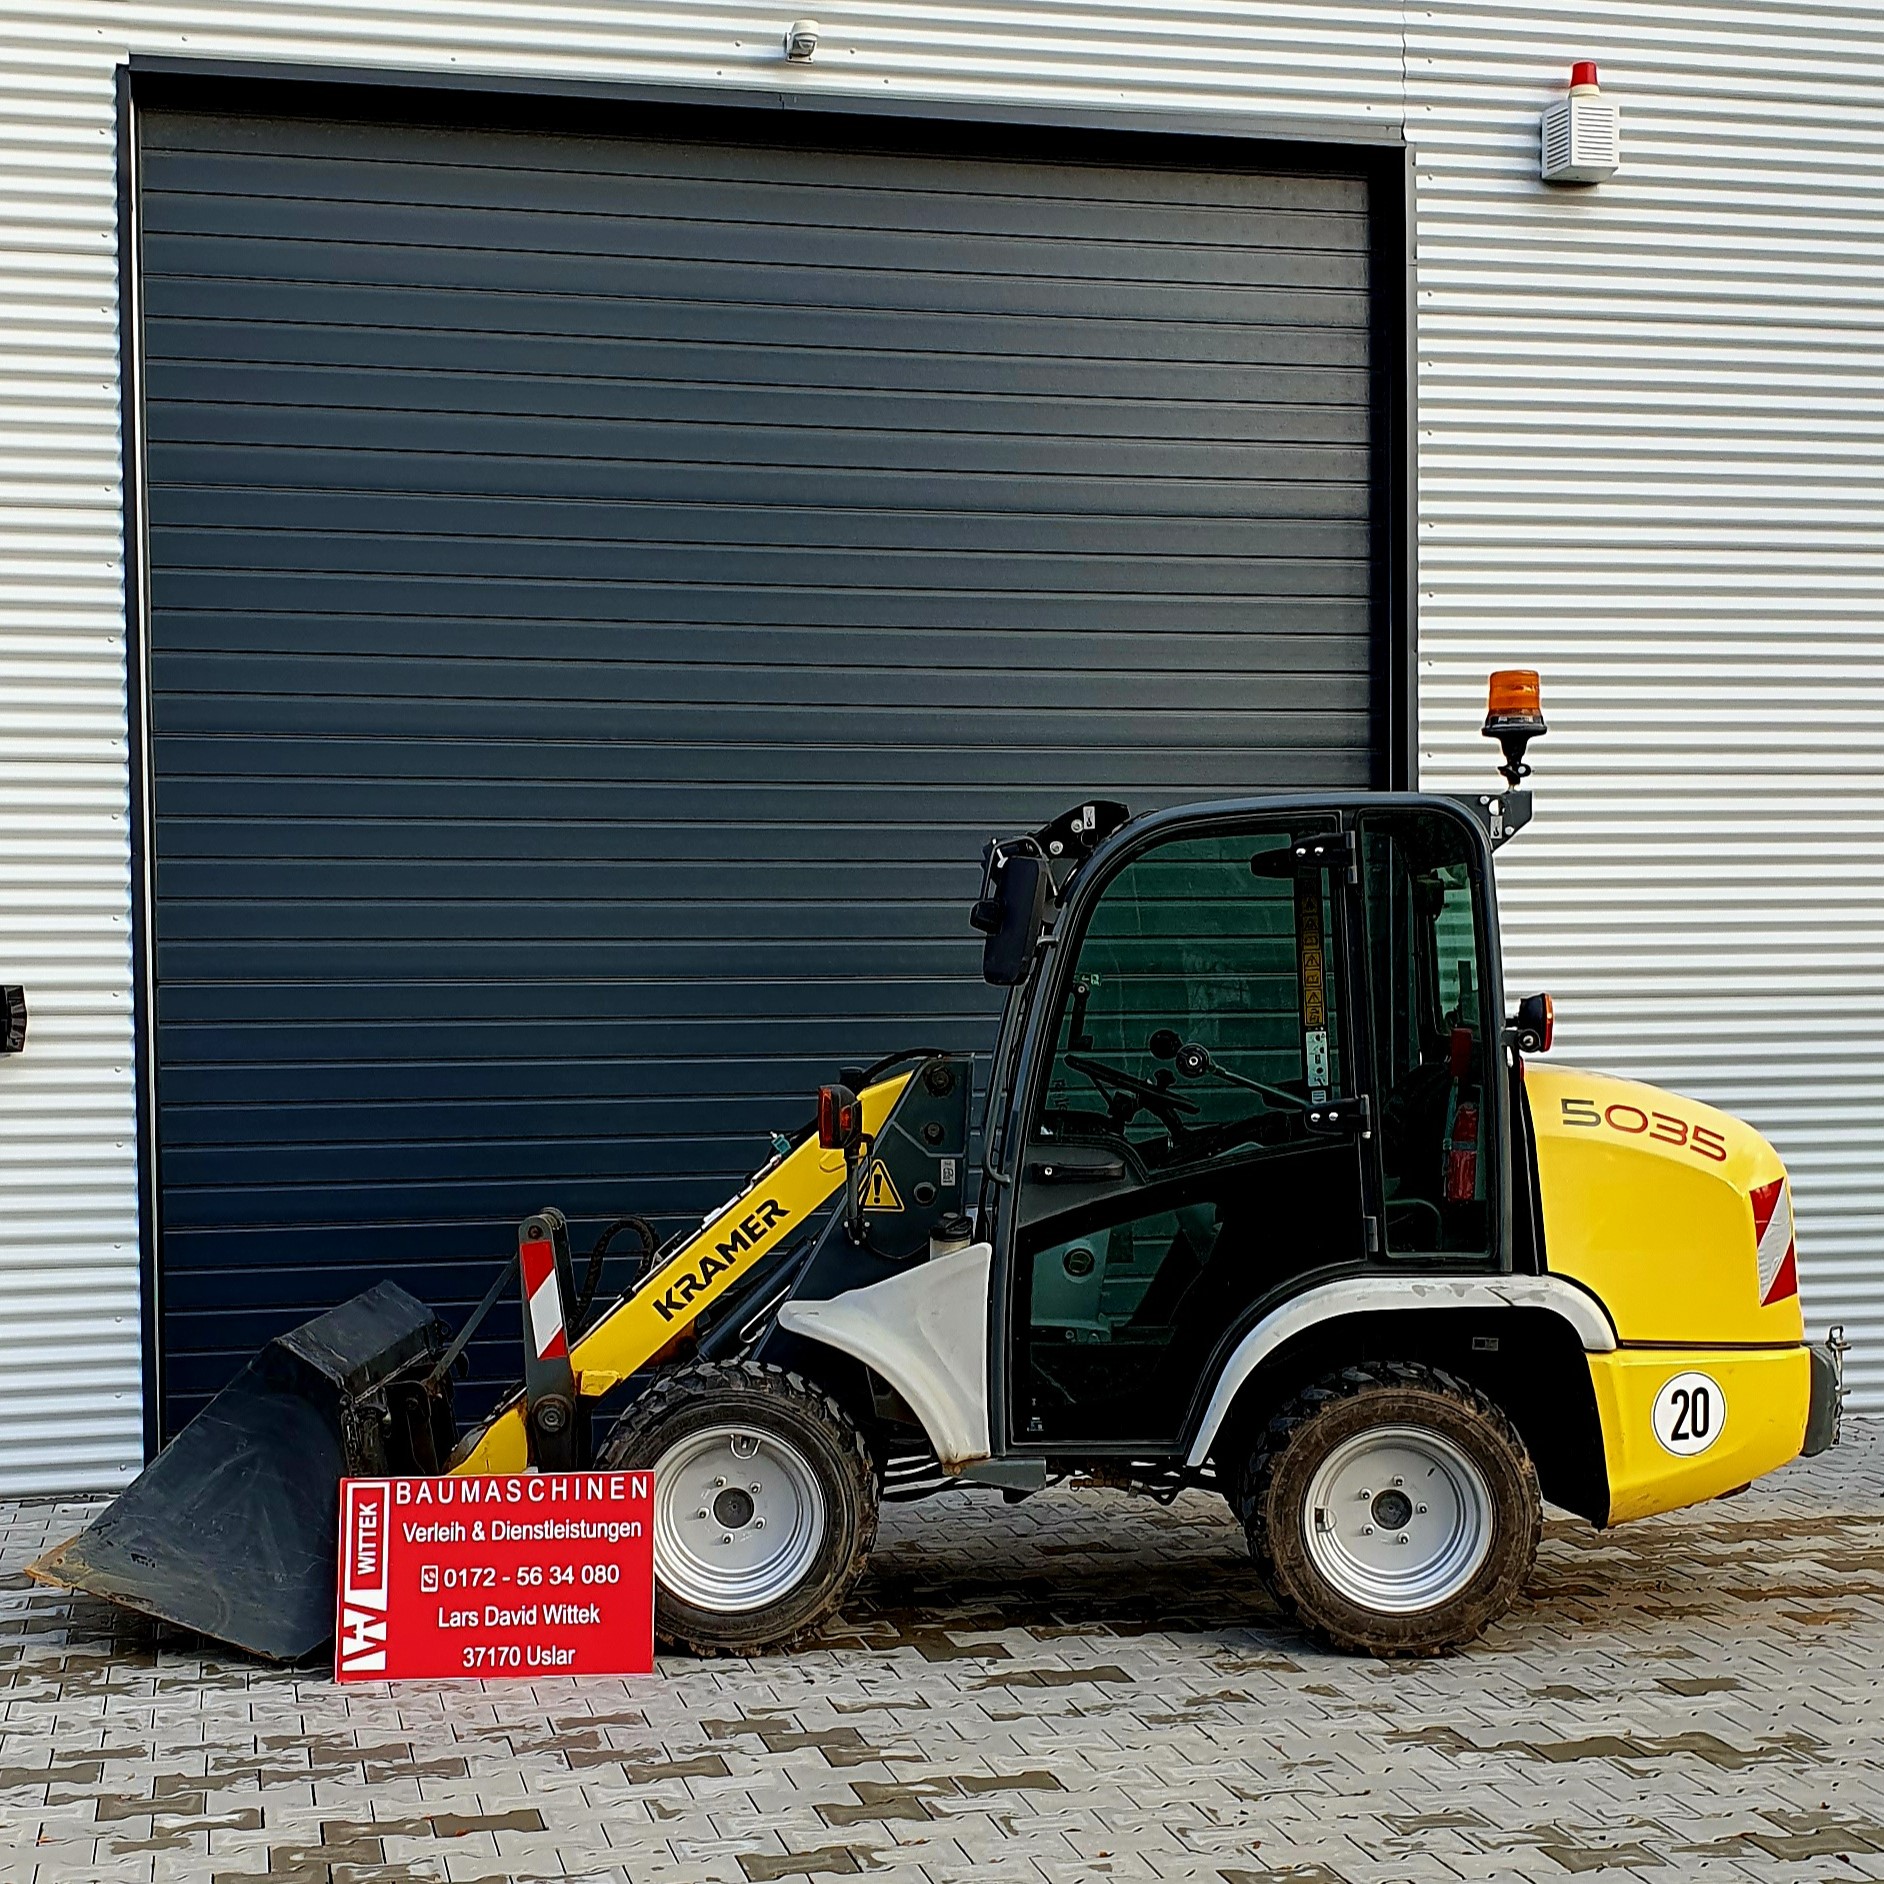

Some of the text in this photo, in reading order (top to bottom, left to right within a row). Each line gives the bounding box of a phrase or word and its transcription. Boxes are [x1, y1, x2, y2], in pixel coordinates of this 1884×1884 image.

[1560, 1098, 1727, 1162] 5035
[652, 1198, 791, 1323] KRAMER
[1670, 1386, 1710, 1441] 20
[396, 1476, 648, 1505] BAUMASCHINEN
[357, 1502, 378, 1576] WITTEK
[402, 1518, 642, 1543] Verleih & Dienstleistungen
[443, 1567, 496, 1588] 0172
[516, 1566, 543, 1586] 56
[549, 1565, 575, 1585] 34
[581, 1564, 620, 1585] 080
[438, 1602, 601, 1628] Lars David Wittek
[462, 1644, 576, 1668] 37170 Uslar
